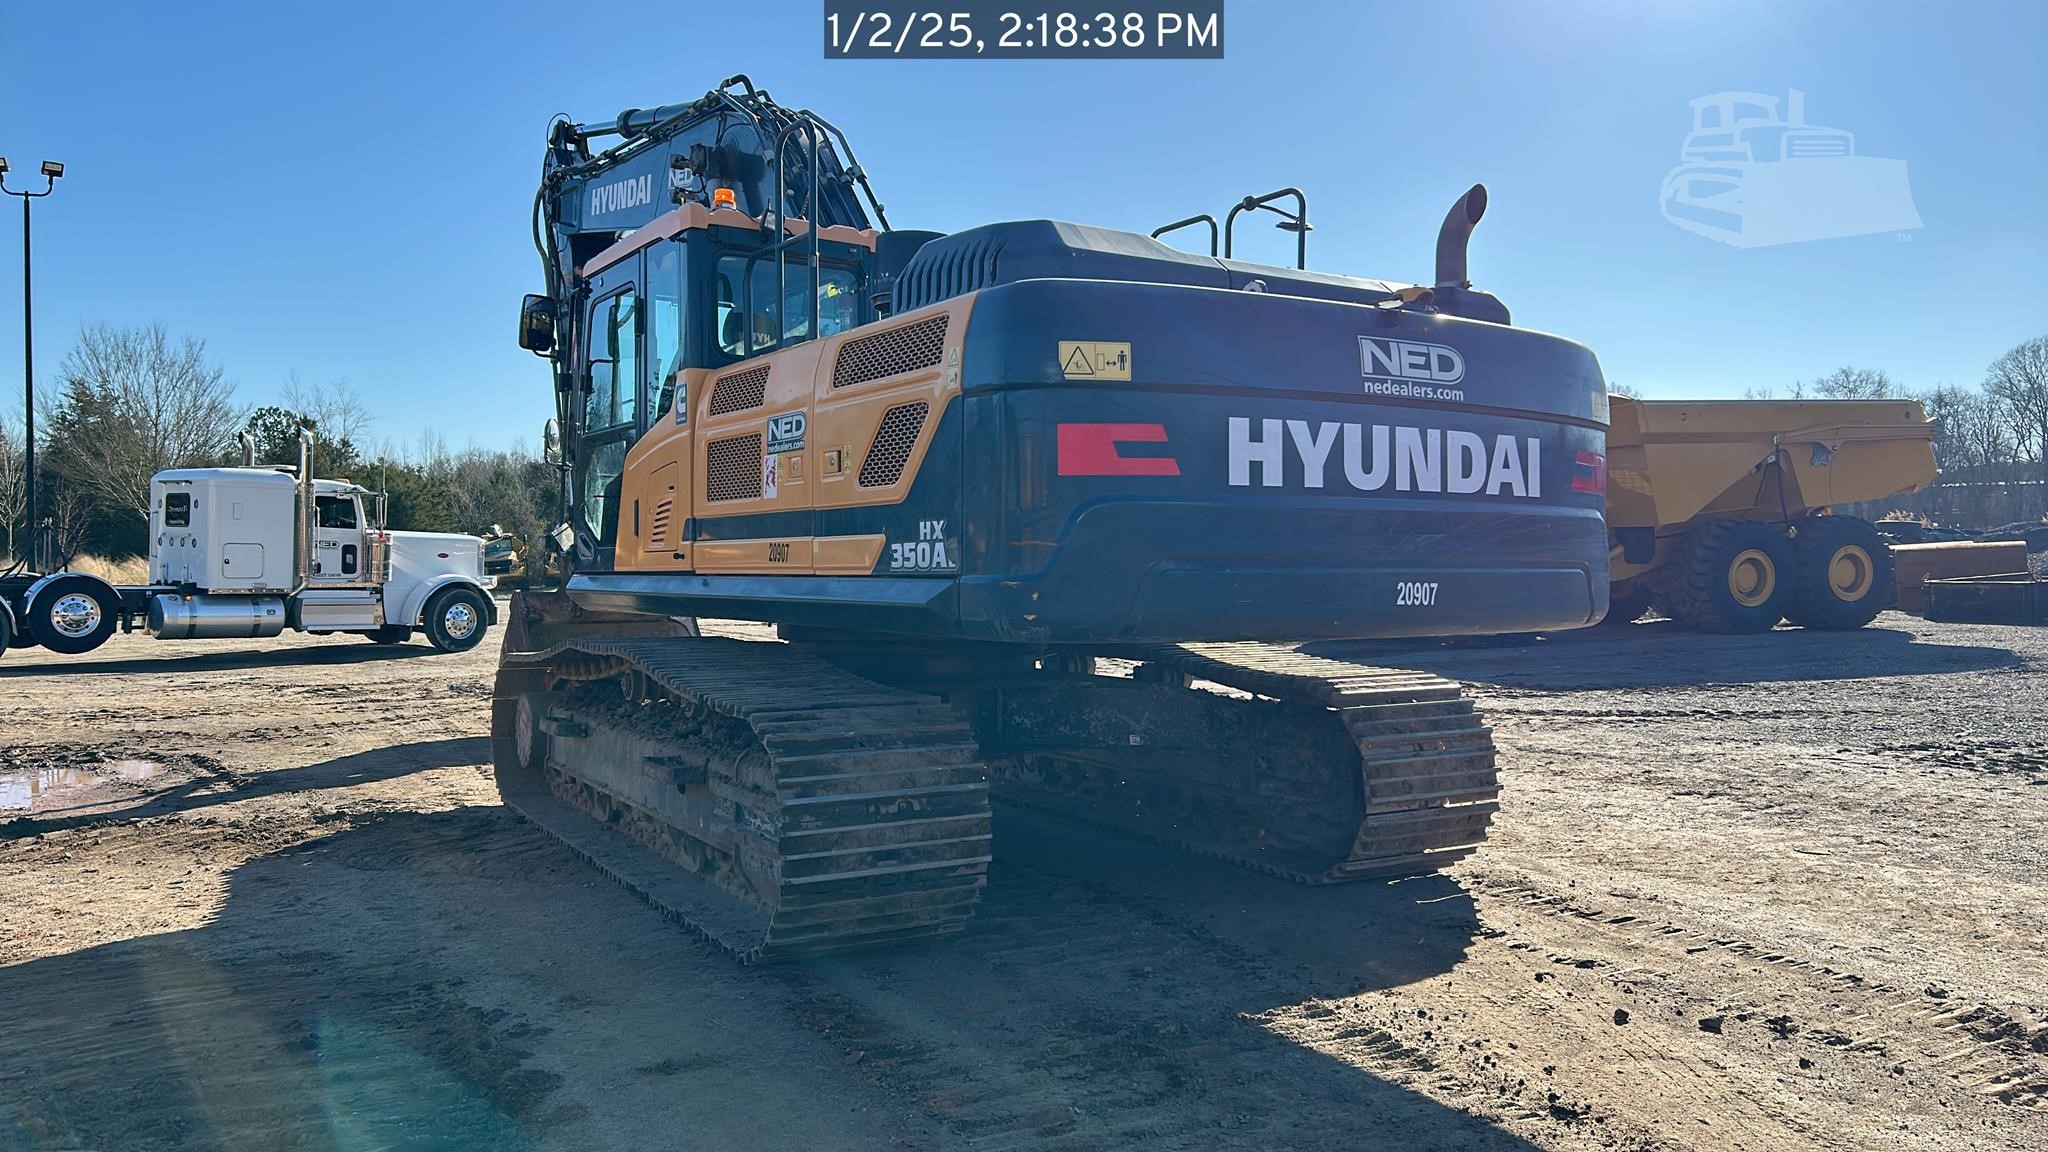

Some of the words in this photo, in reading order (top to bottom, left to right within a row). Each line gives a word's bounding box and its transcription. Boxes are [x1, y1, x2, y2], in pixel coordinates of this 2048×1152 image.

[591, 174, 652, 216] HYUNDAI
[1360, 339, 1463, 381] NED
[1364, 380, 1464, 402] nedealers.com
[768, 414, 806, 441] NED
[768, 442, 804, 453] nedealers.com
[1228, 417, 1541, 498] HYUNDAI
[919, 520, 945, 541] HX
[768, 543, 790, 563] 20907
[1396, 582, 1438, 606] 20907
